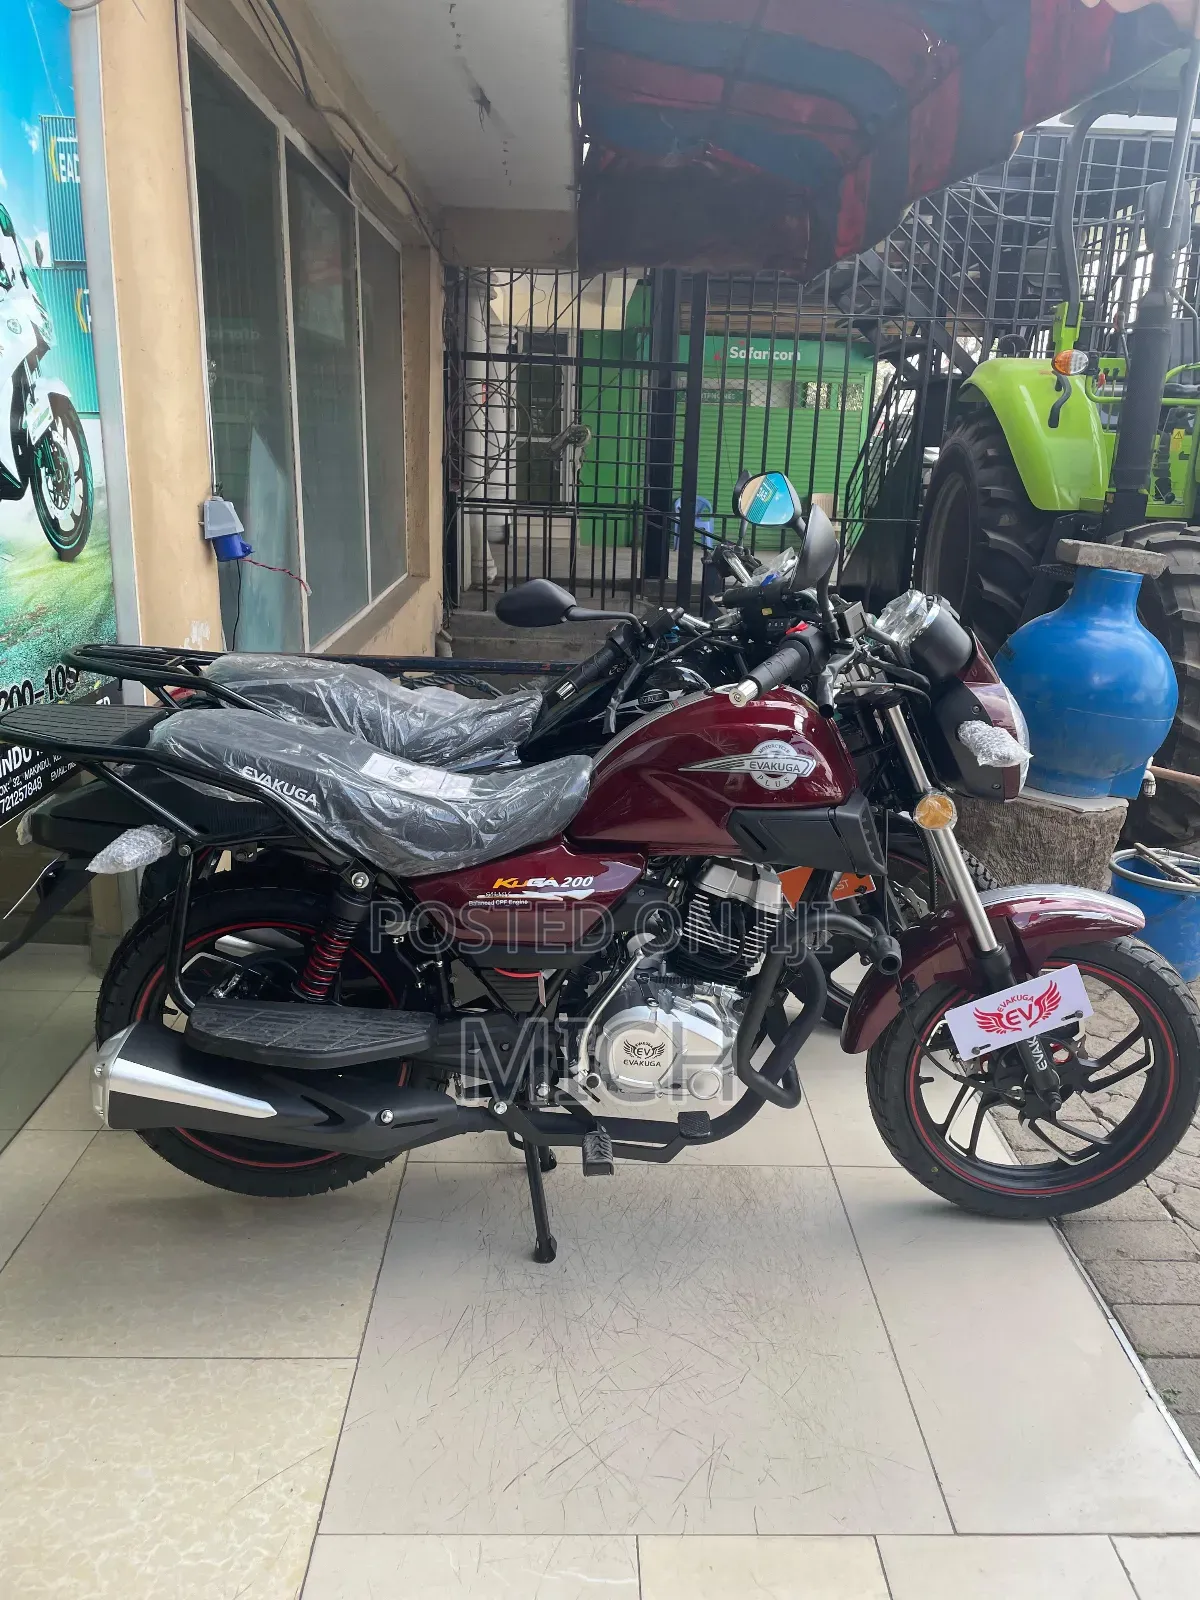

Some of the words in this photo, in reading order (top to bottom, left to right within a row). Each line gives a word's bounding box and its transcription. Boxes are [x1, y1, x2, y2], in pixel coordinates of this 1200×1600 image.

[749, 761, 801, 773] EVAKUGA
[240, 766, 317, 808] EVAKUGA
[757, 774, 790, 787] PLUS
[0, 776, 43, 814] 721257848
[560, 876, 594, 888] 200
[997, 994, 1035, 1012] EVAKUGA
[1006, 1003, 1033, 1026] EV
[636, 1047, 651, 1056] EV
[623, 1059, 662, 1068] EVAKUGA
